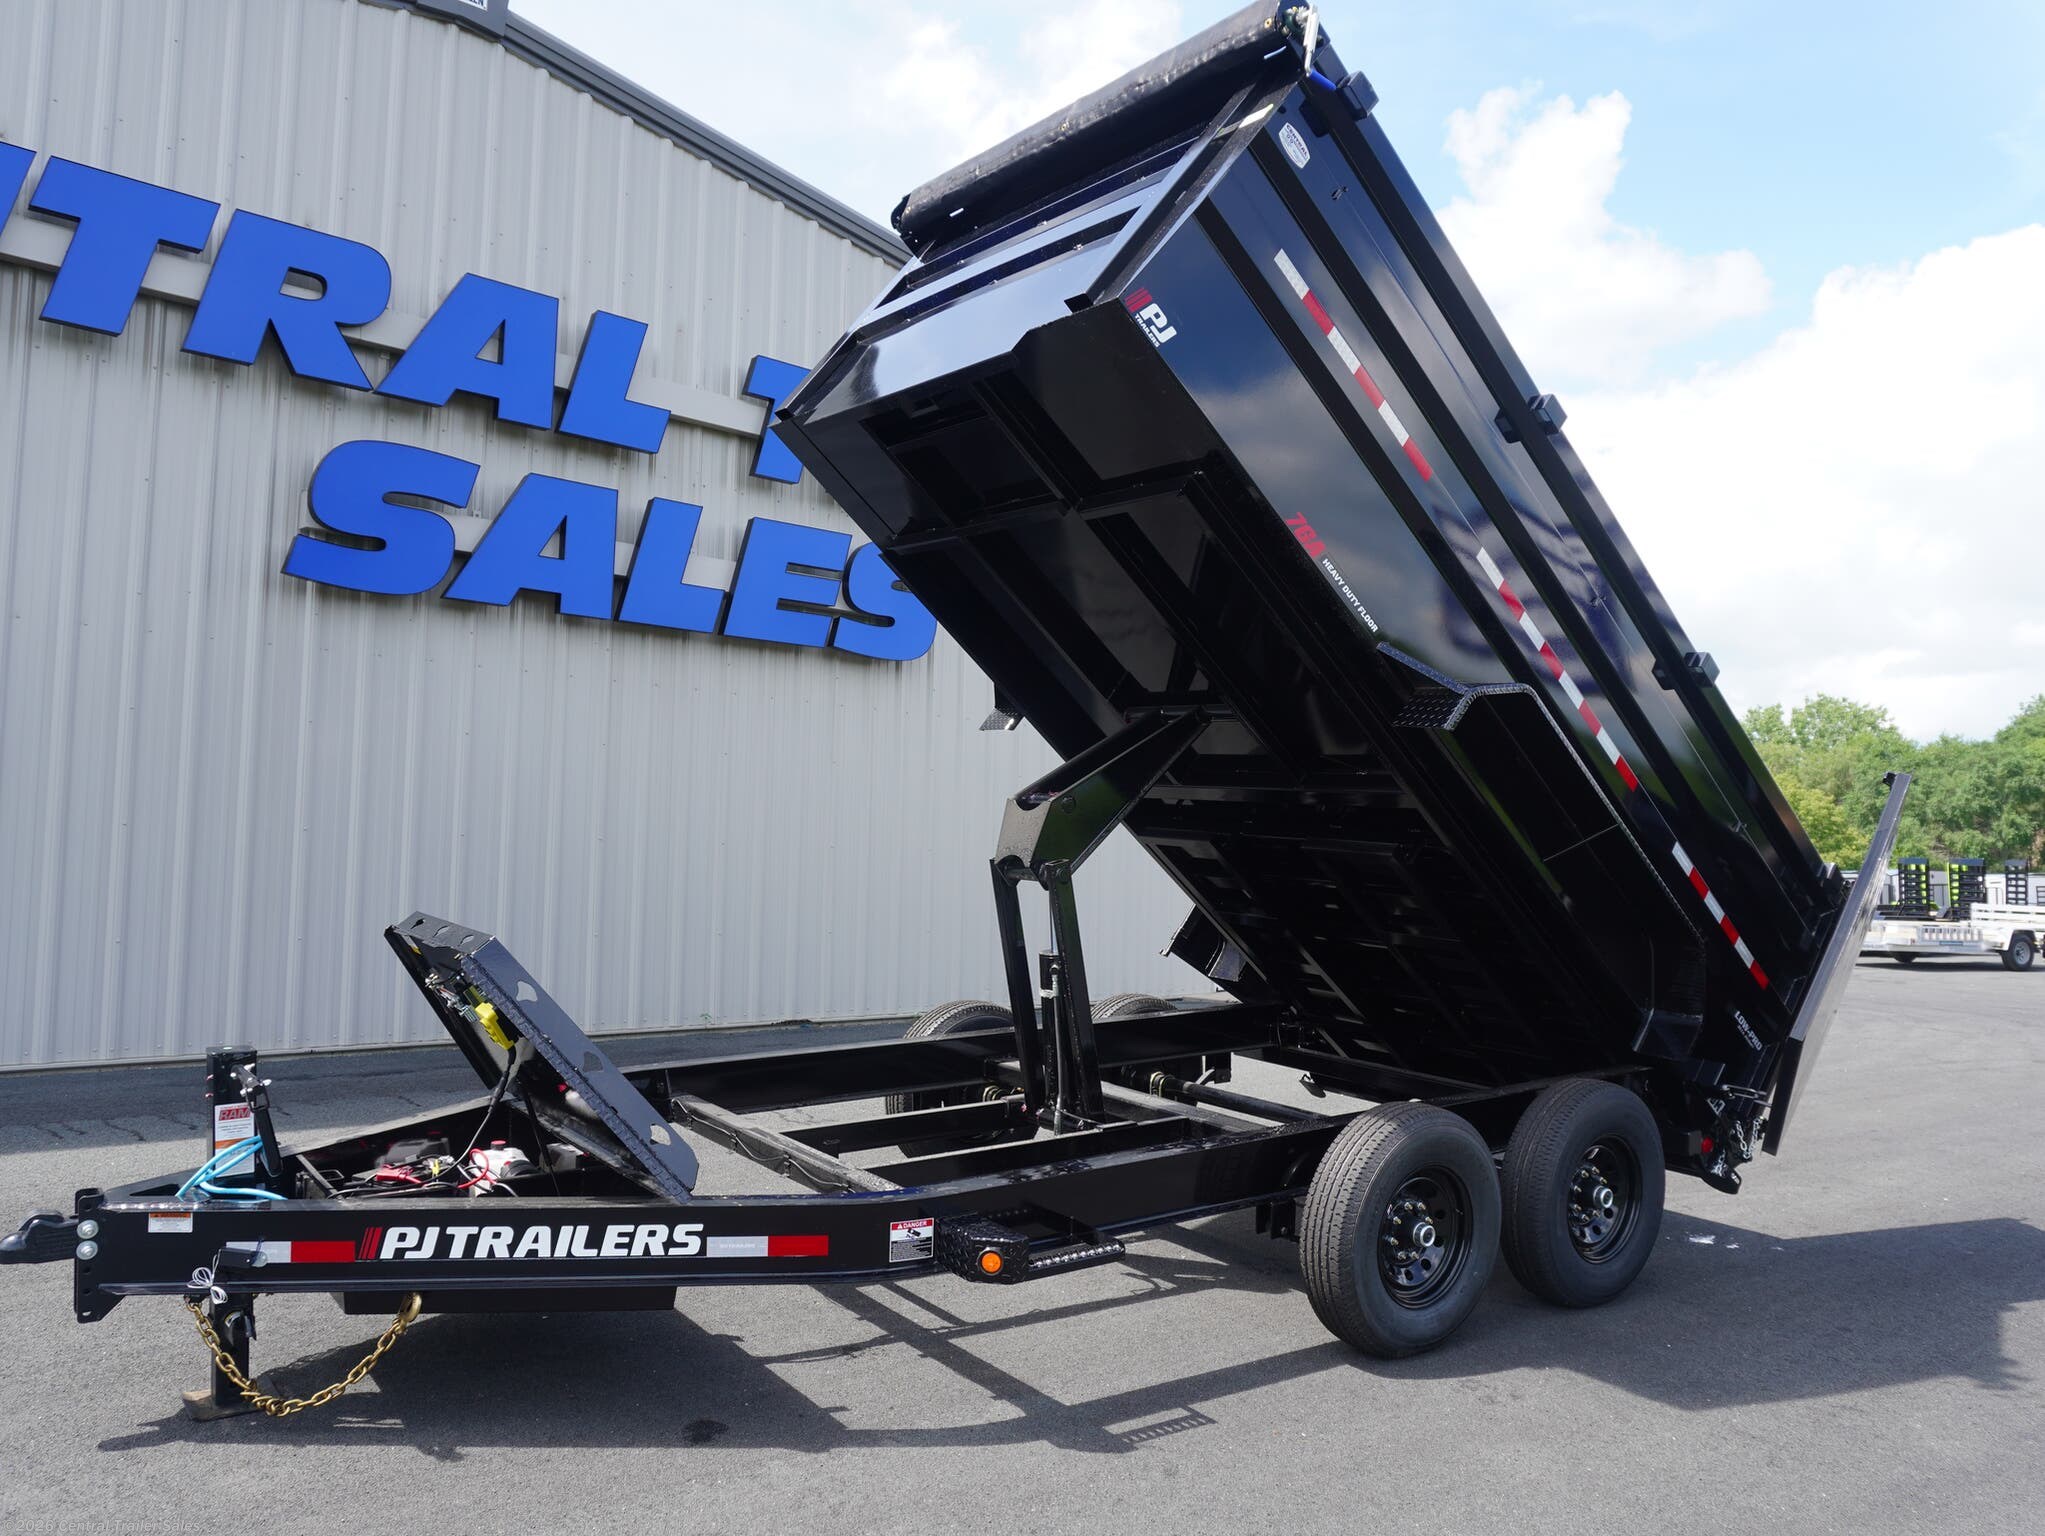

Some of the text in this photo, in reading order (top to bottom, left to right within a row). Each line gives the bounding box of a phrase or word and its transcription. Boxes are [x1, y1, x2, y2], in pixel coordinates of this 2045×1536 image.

[0, 141, 671, 454] TRAL
[1134, 312, 1161, 348] TRAILERS
[1139, 303, 1178, 343] PJ
[281, 439, 937, 661] SALES
[1286, 512, 1325, 557] 7GA
[1322, 558, 1379, 633] HEAVY DUTY FLOOR
[1734, 1010, 1763, 1051] LOW-PRO
[218, 1107, 252, 1120] RAM
[380, 1223, 704, 1259] PJ TRAILERS
[902, 1220, 928, 1229] DANGER
